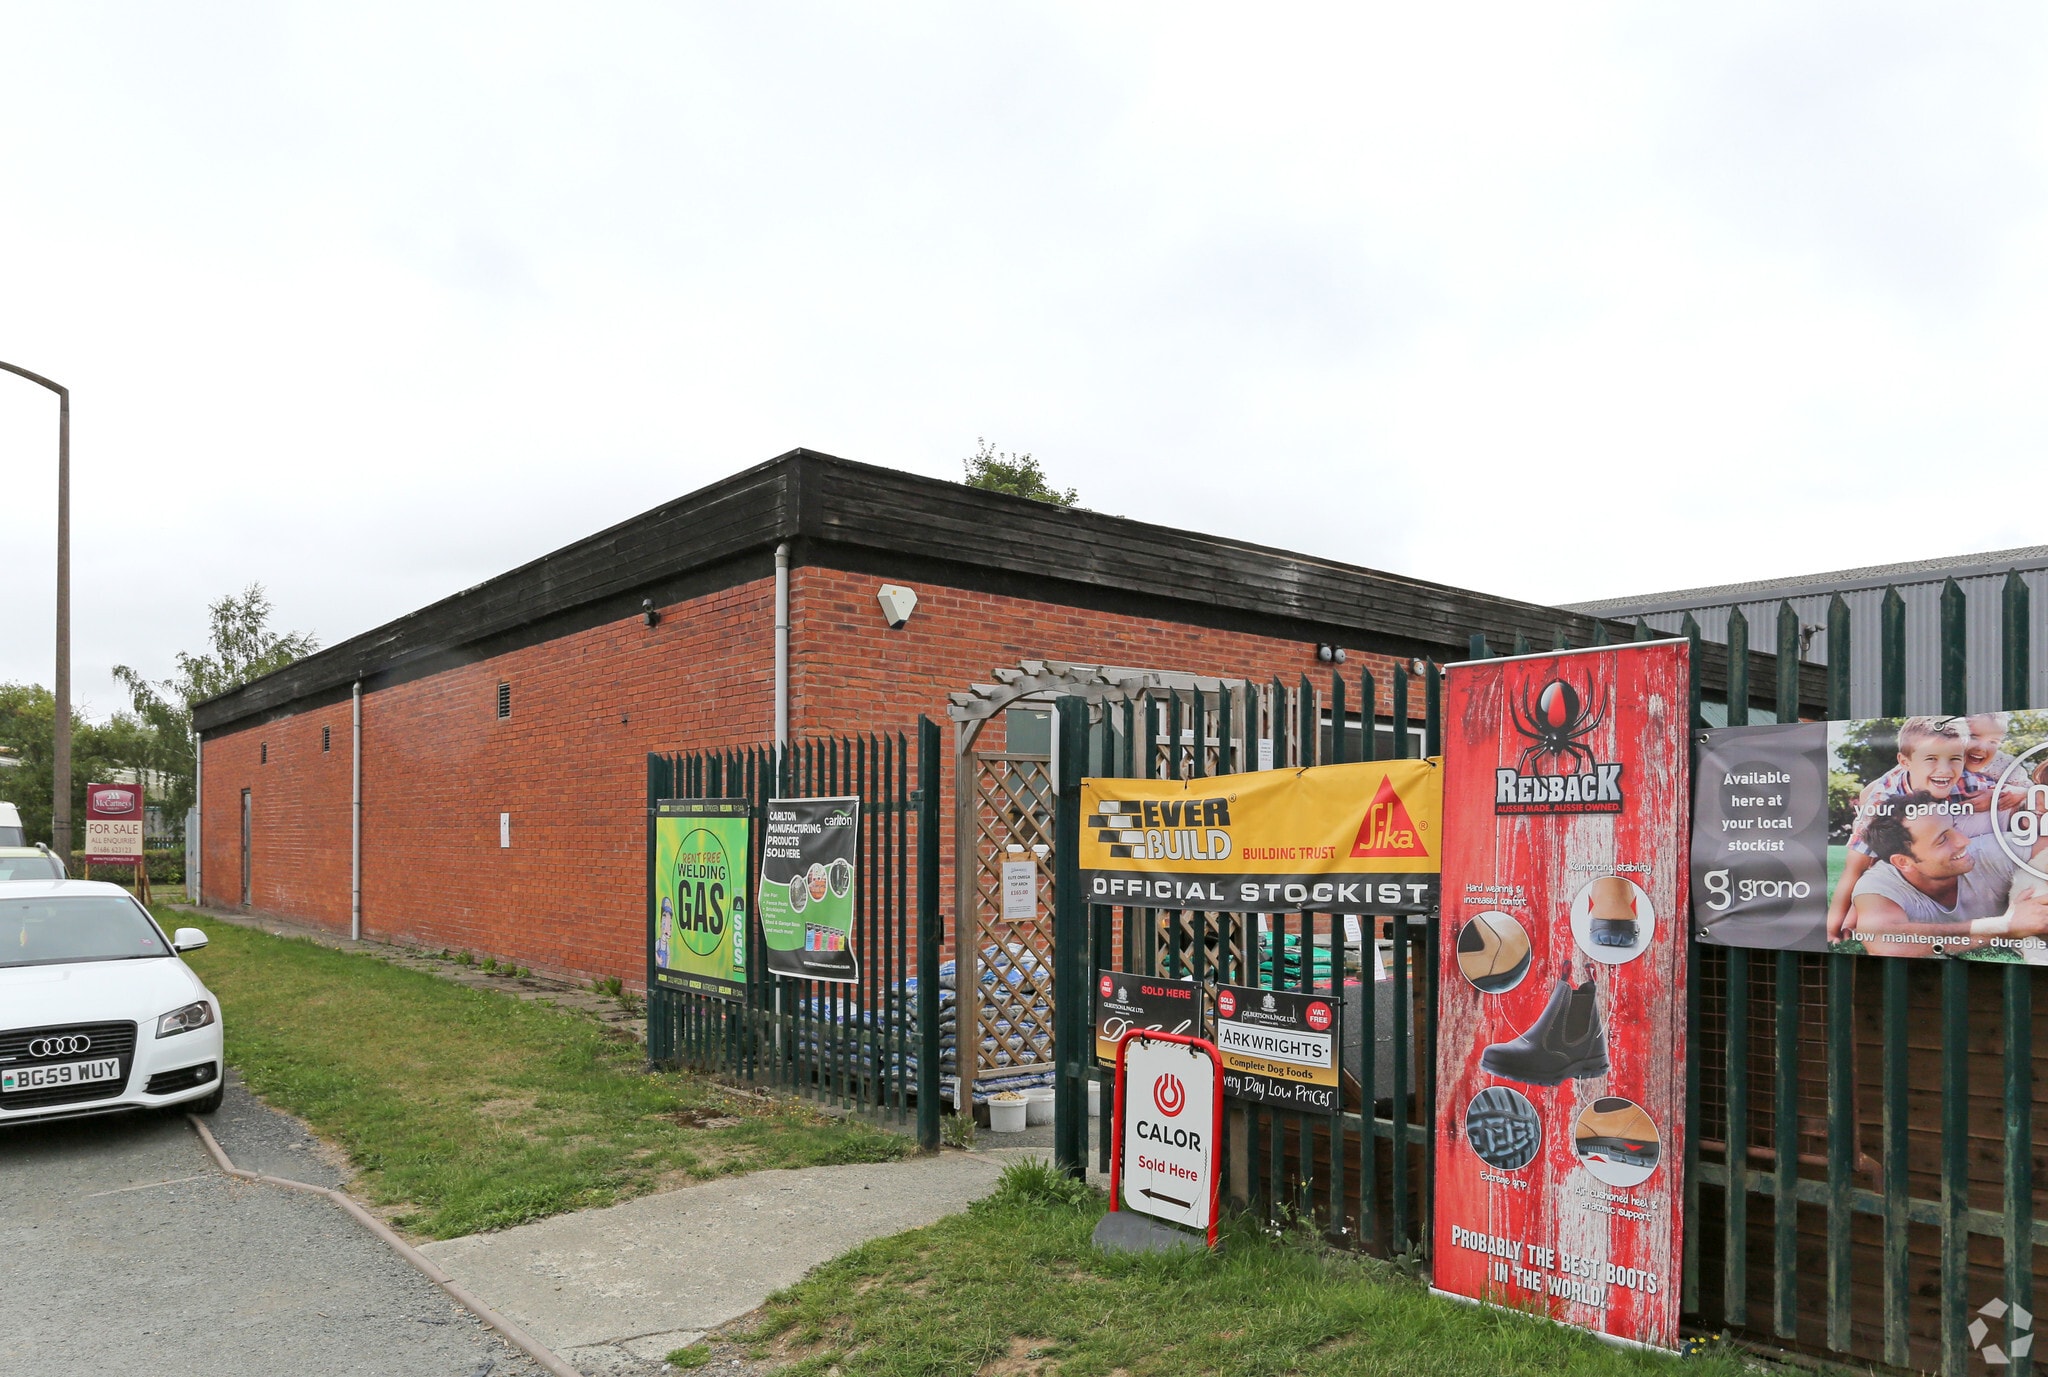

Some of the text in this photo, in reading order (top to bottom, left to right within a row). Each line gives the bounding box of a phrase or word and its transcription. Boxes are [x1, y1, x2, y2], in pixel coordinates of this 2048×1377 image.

[1497, 764, 1622, 804] REDBACK
[1723, 772, 1791, 786] Available
[96, 799, 132, 808] McCartneys
[1496, 802, 1622, 814] AUSSIE MADE. AUSSIE OWNED.
[1731, 794, 1782, 807] here at
[770, 812, 797, 821] CARLTON
[1143, 797, 1231, 828] EVER
[1854, 800, 1974, 821] your garden
[768, 824, 822, 834] MANUFACTURING
[824, 814, 852, 826] carlton
[1359, 802, 1415, 851] Sika
[1722, 816, 1793, 832] your local
[89, 824, 139, 835] FOR SALE
[103, 837, 137, 845] ENQUIRIES
[768, 836, 800, 846] PRODUCTS
[1146, 829, 1232, 861] BUILD
[1727, 839, 1785, 852] stockist
[682, 852, 721, 864] RENT FREE
[766, 848, 801, 859] SOLD HERE
[1242, 846, 1336, 861] BUILDING TRUST
[678, 863, 726, 880] WELDING
[1570, 861, 1652, 875] Reinforcing stability
[1093, 877, 1430, 905] OFFICIAL STOCKIST
[1466, 883, 1484, 892] Hard
[1486, 884, 1514, 896] wearing
[1738, 879, 1811, 902] grono
[678, 880, 724, 935] GAS
[1464, 895, 1527, 906] increased comfort
[733, 914, 743, 965] SGS
[1851, 930, 2047, 950] low maintenance durable
[1141, 985, 1192, 1000] SOLD HERE
[1310, 1016, 1328, 1024] FREE
[1223, 1028, 1322, 1058] ARKWRIGHTS
[17, 1060, 116, 1088] BG59 WUY
[1229, 1056, 1314, 1079] Complete Dog Foods
[1223, 1076, 1240, 1096] very
[1244, 1076, 1265, 1101] Day
[1268, 1079, 1292, 1098] Low
[1136, 1120, 1201, 1152] CALOR
[1138, 1155, 1198, 1182] Sold Here
[1480, 1170, 1528, 1189] Extreme grip
[1590, 1188, 1629, 1205] cushioned
[1631, 1196, 1648, 1208] heel
[1651, 1200, 1658, 1210] &
[1581, 1201, 1652, 1222] anatomic support
[1452, 1224, 1658, 1295] PROBABLY THE BEST BOOTS
[1494, 1262, 1606, 1309] IN THE WORLD!
